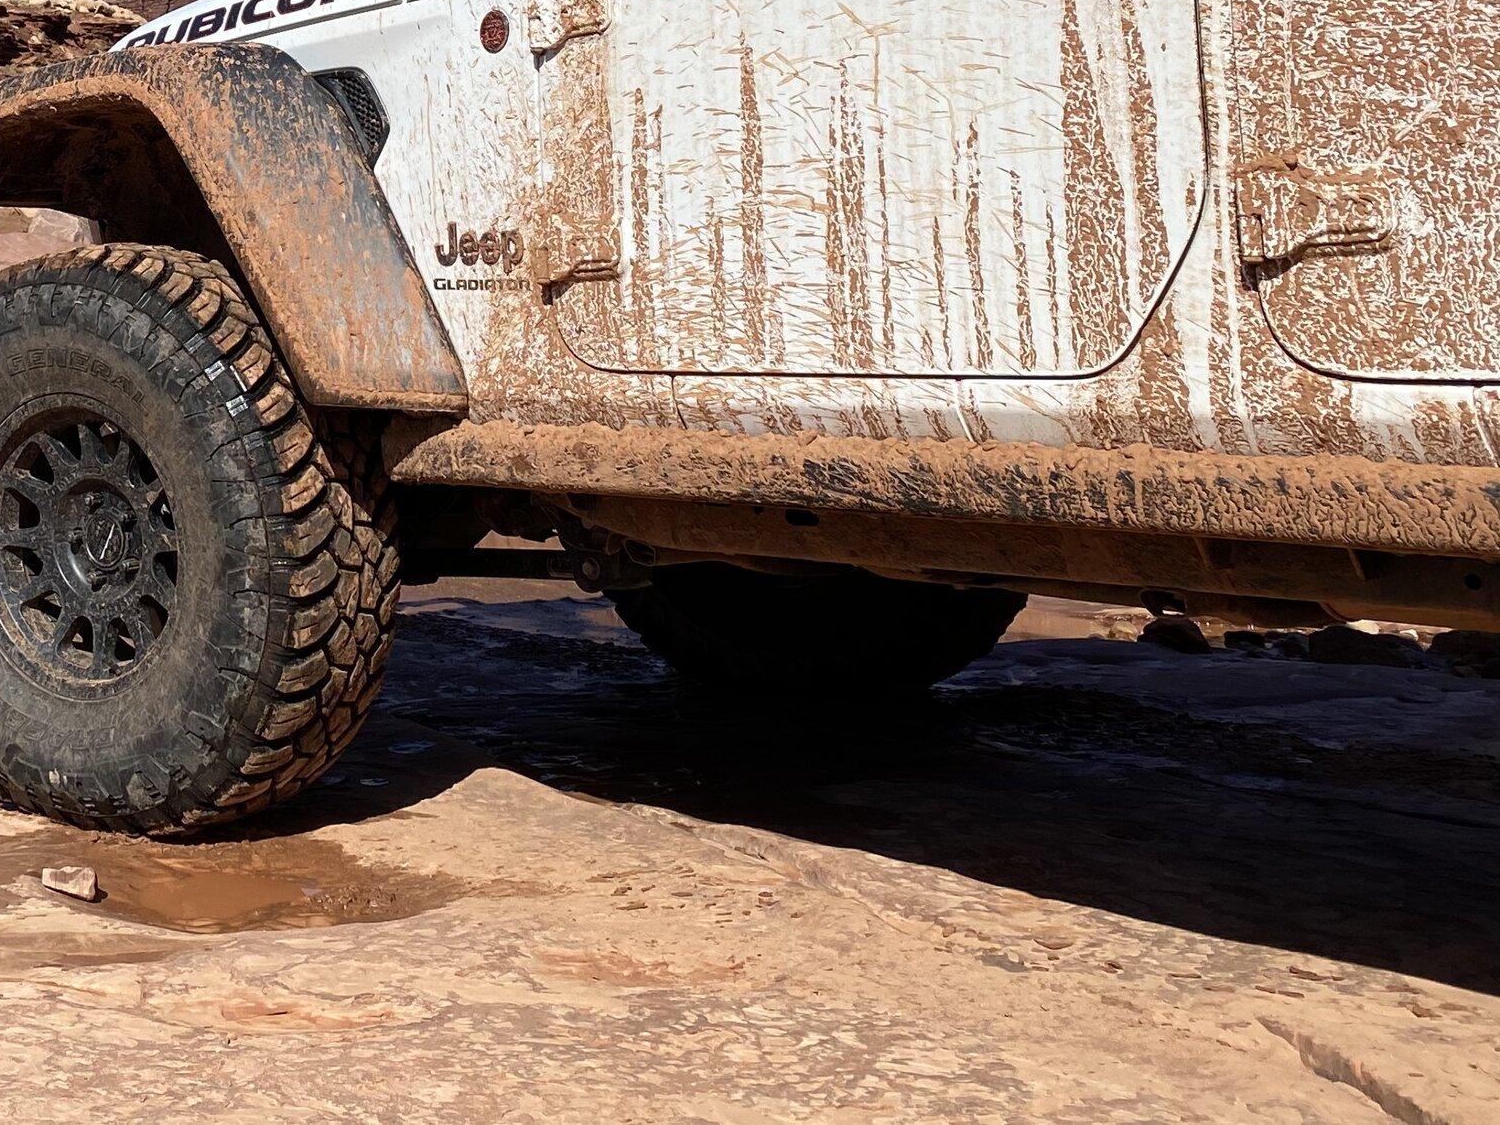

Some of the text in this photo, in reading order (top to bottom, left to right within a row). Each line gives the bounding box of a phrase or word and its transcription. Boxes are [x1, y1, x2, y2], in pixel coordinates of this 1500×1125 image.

[434, 221, 524, 274] Jeep
[433, 278, 532, 291] GLADIATOR
[6, 343, 150, 417] GENERAL
